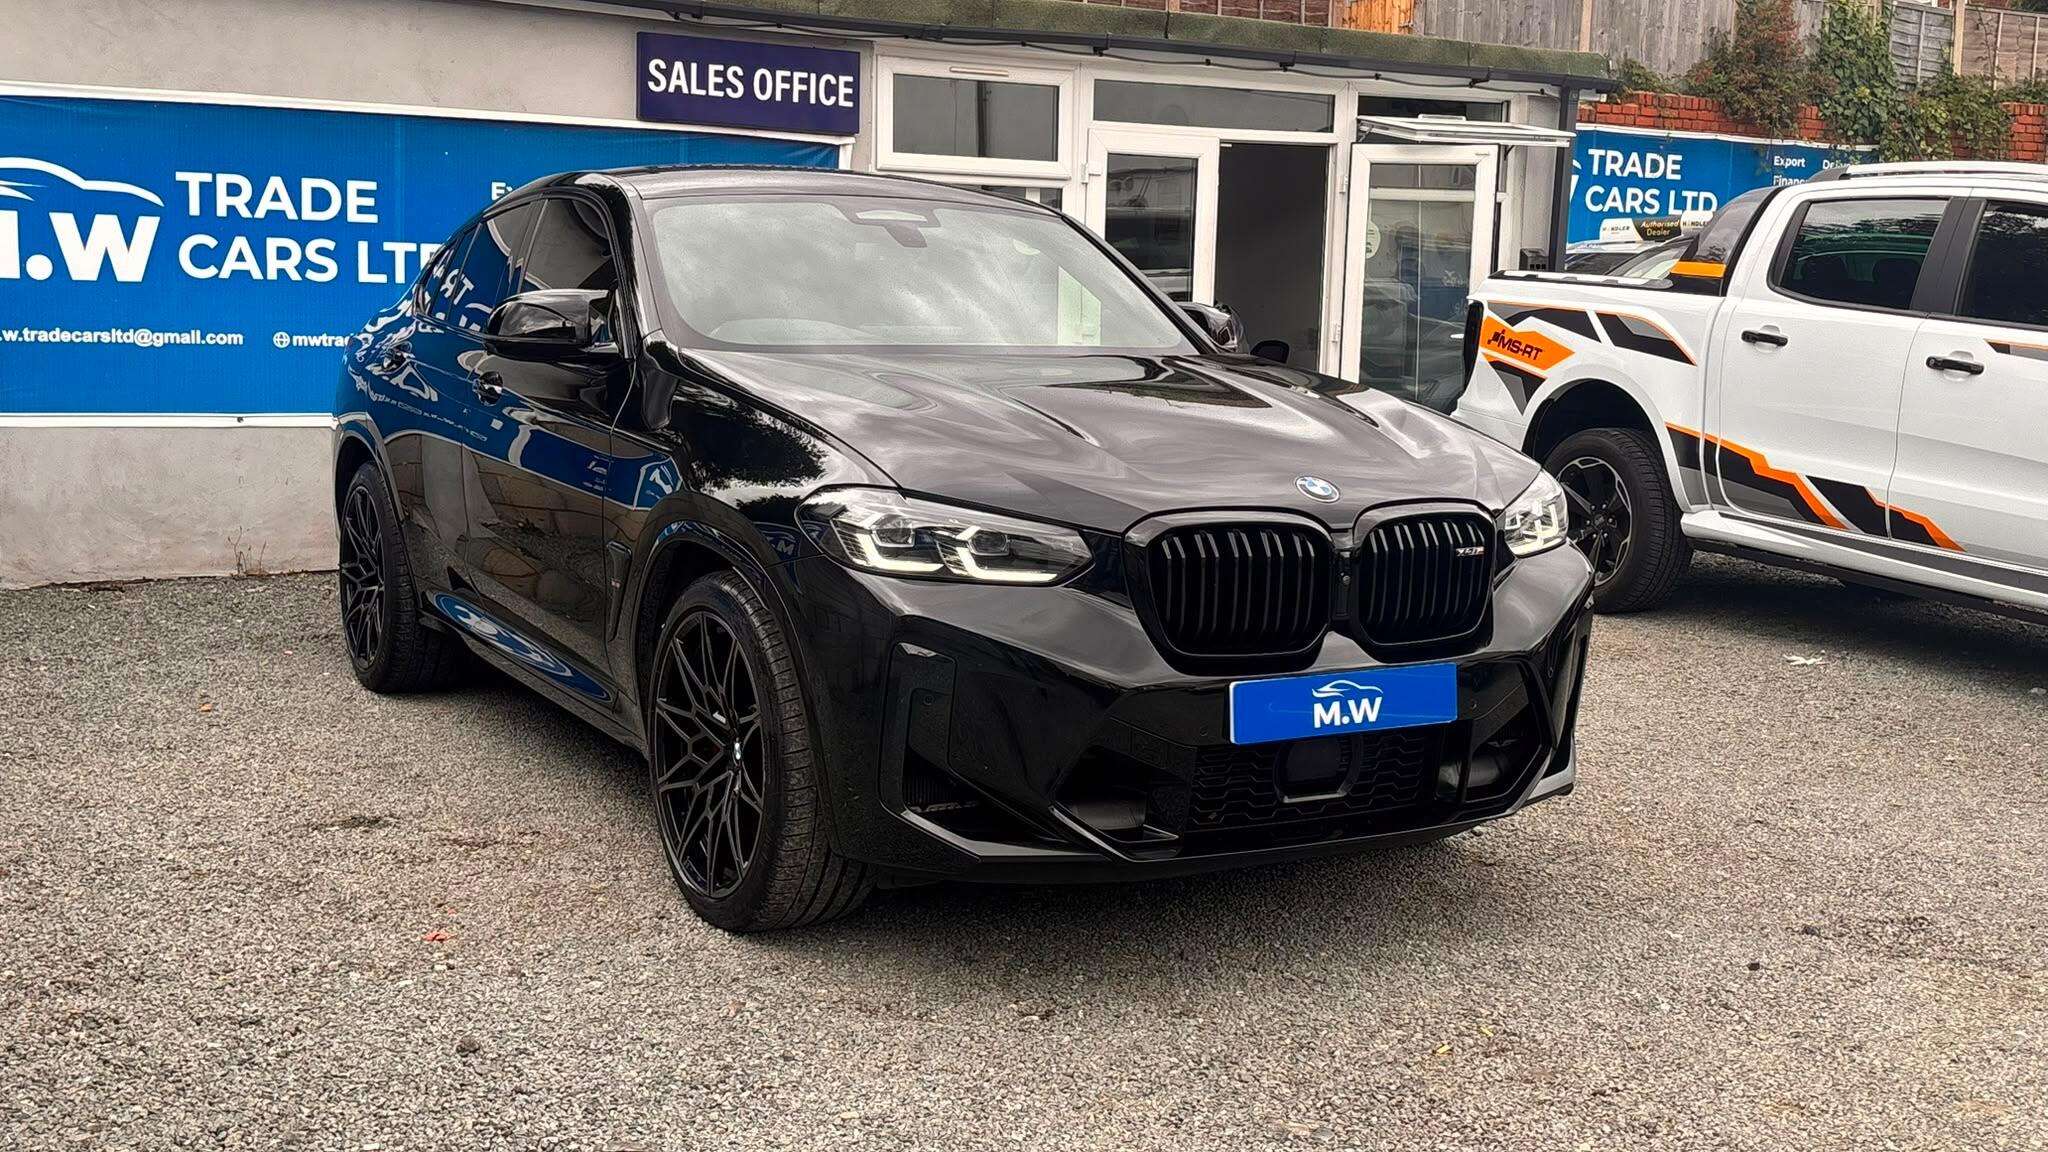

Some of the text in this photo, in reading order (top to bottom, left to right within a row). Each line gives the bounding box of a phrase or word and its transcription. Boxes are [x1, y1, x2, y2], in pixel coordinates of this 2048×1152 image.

[648, 58, 853, 107] SALES OFFICE
[1588, 149, 1682, 181] TRADE
[1774, 156, 1805, 168] Export
[175, 171, 378, 224] TRADE
[491, 181, 514, 201] E
[1585, 185, 1718, 215] CARS LTD
[0, 209, 161, 283] .W
[1646, 228, 1671, 237] Dealer
[178, 233, 339, 281] CARS
[1497, 335, 1543, 361] MS-RT
[1314, 697, 1383, 729] M.W
